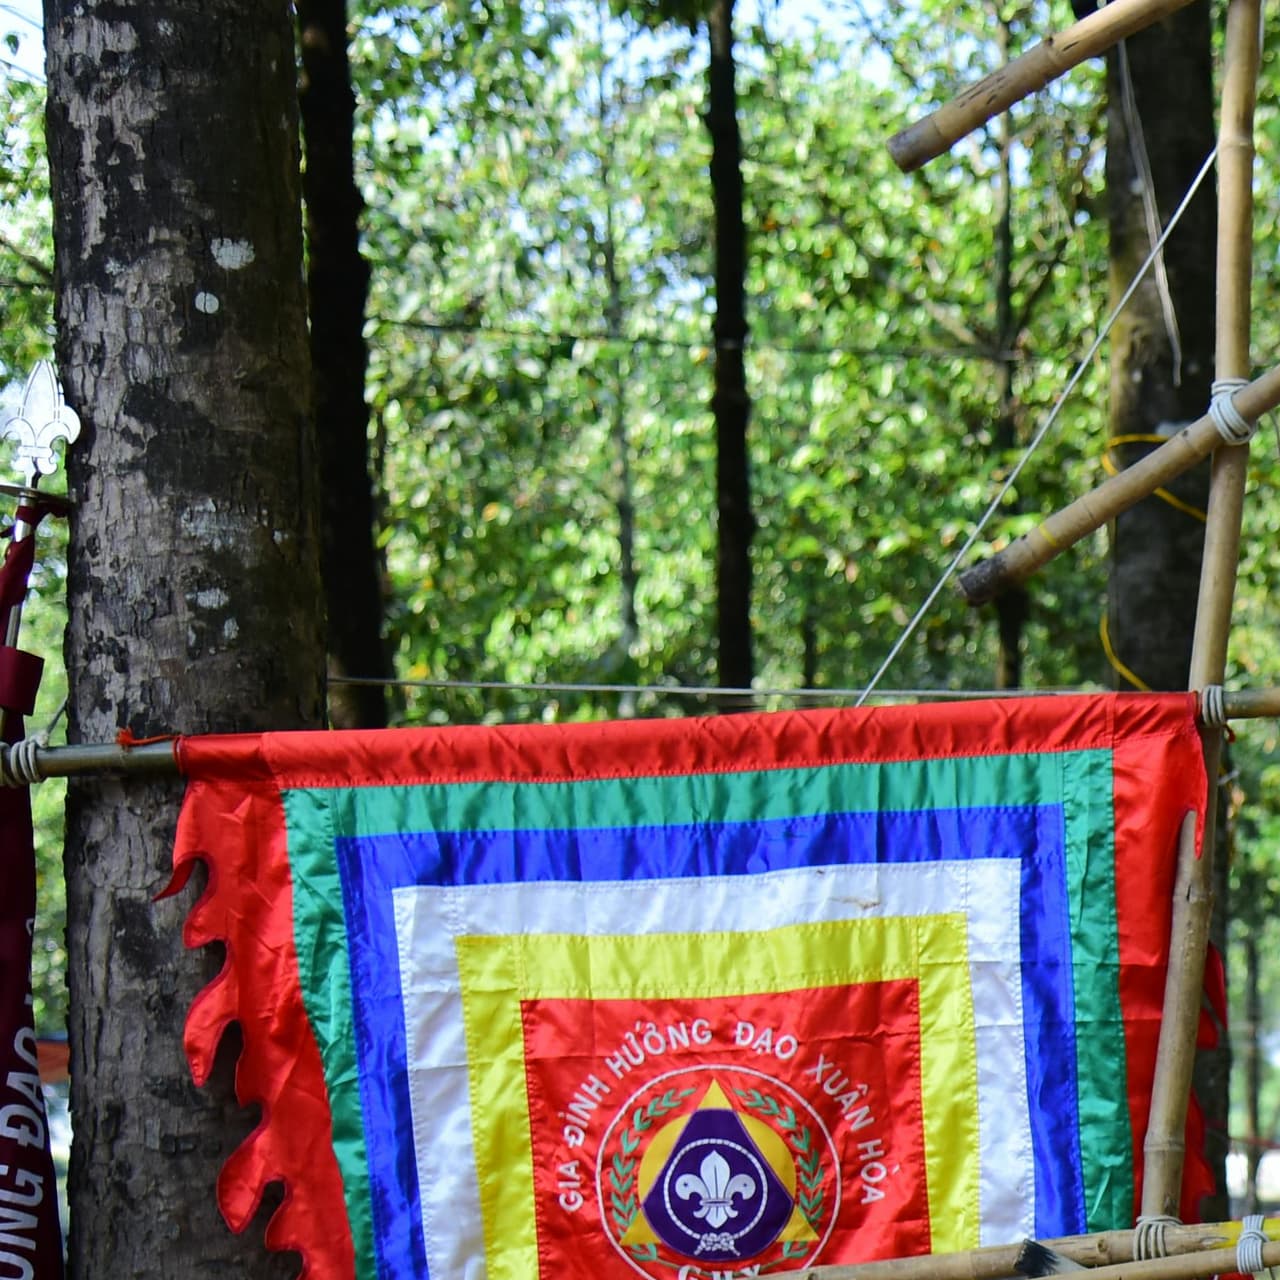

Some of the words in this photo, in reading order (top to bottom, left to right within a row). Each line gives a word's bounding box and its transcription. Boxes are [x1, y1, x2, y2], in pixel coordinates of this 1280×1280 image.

[559, 1160, 584, 1212] GIA
[735, 1022, 799, 1060] ĐẠO
[806, 1053, 875, 1131] XUÂN
[857, 1139, 900, 1206] HÒA
